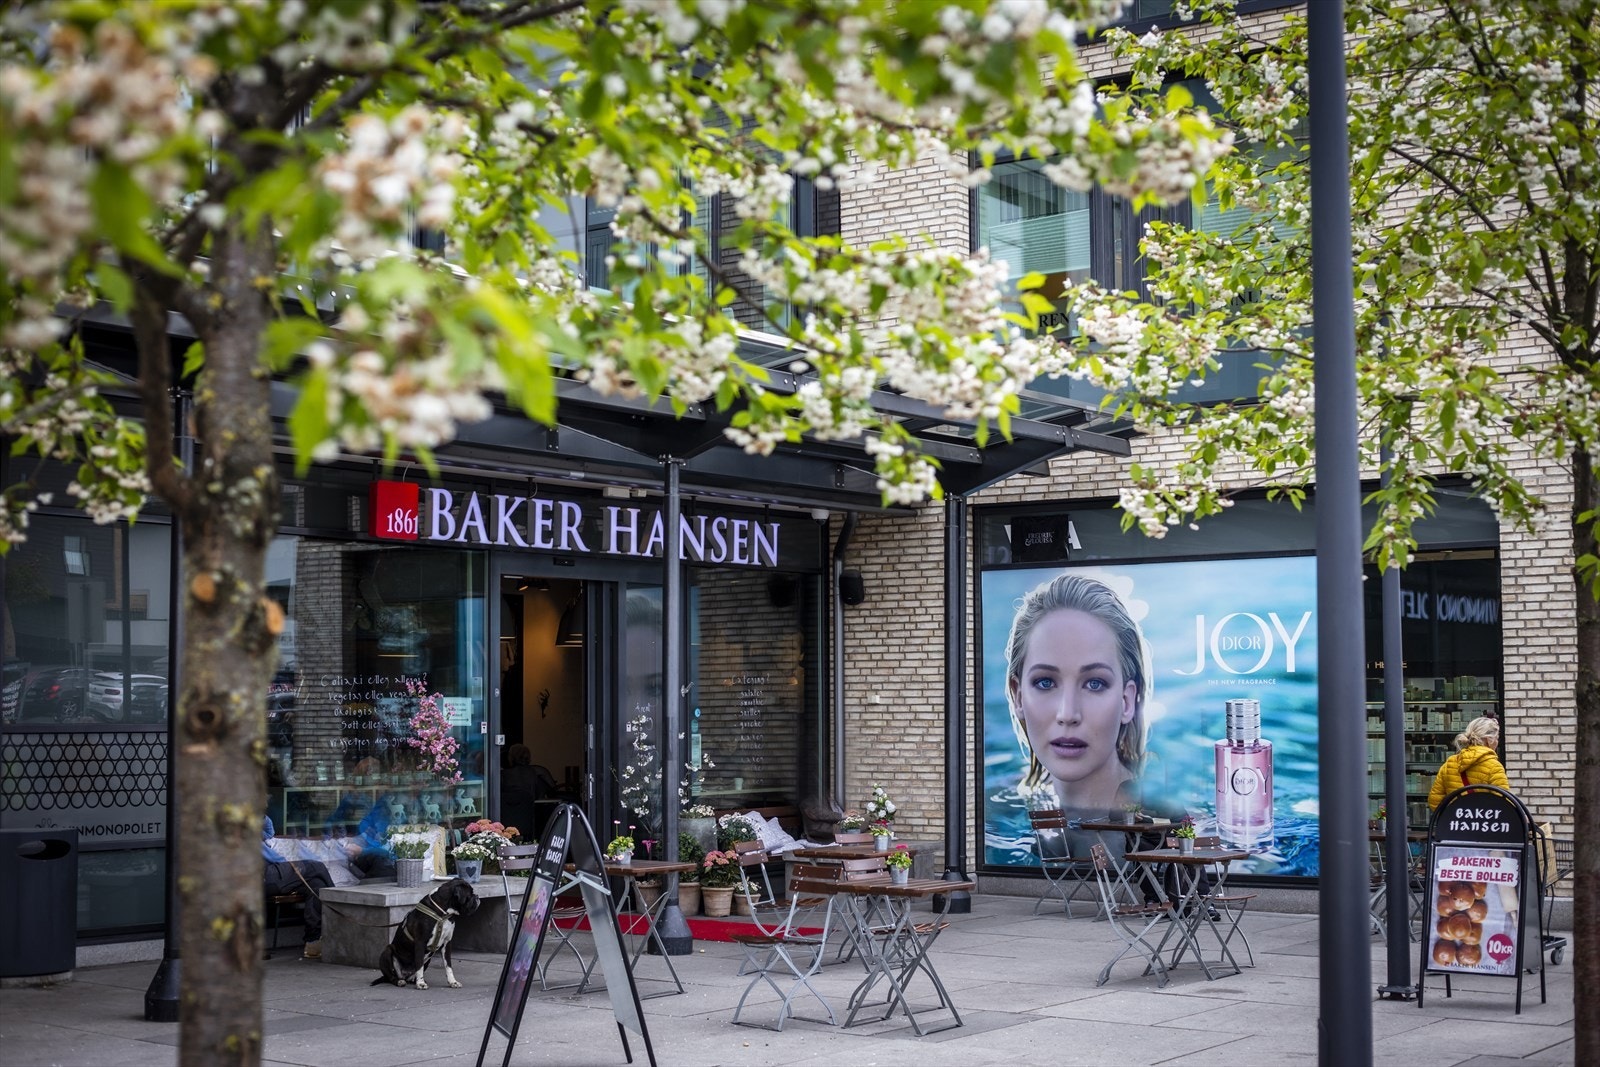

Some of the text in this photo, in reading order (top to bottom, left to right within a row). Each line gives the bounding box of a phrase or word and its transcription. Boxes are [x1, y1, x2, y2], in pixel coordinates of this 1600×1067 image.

[387, 508, 418, 535] 1861
[428, 487, 780, 567] BAKER HANSEN
[1173, 611, 1312, 676] JOY
[1222, 636, 1261, 650] DIOR
[1452, 856, 1501, 869] BAKERN'S
[1440, 869, 1515, 883] BESTE BOLLER
